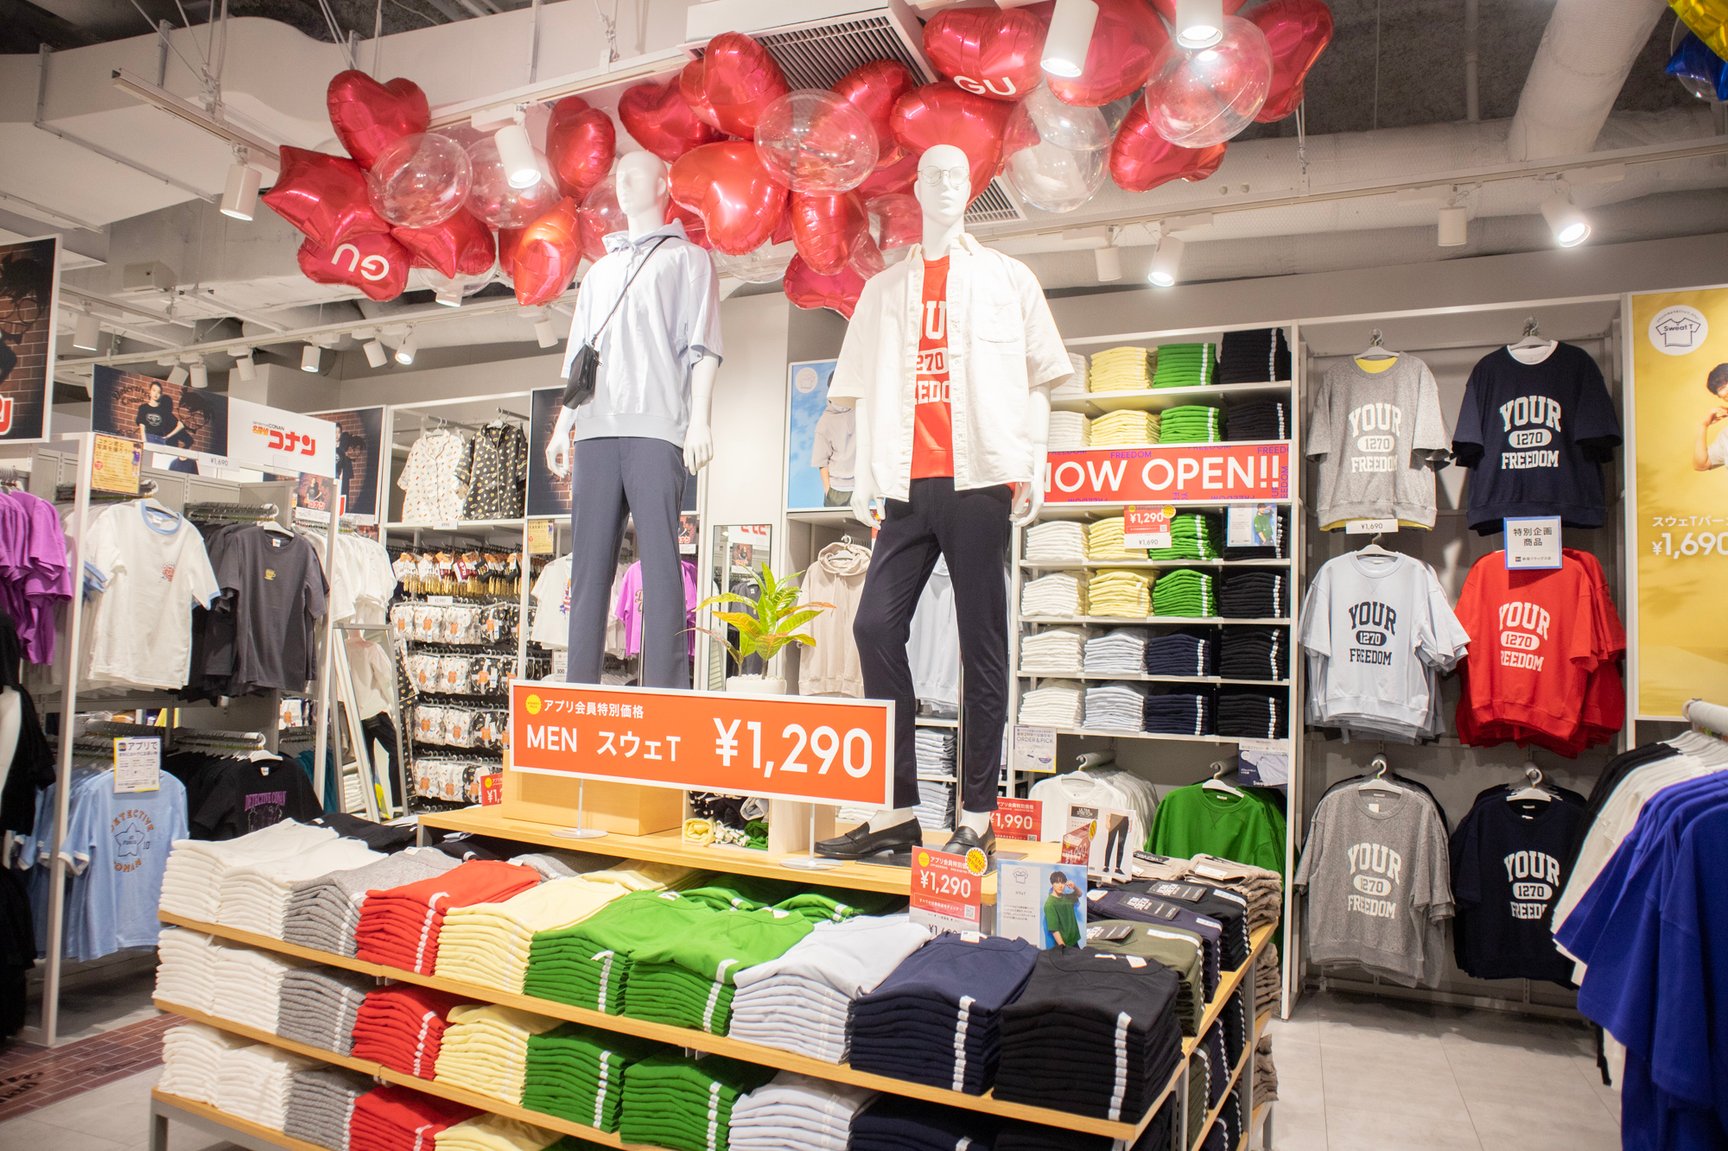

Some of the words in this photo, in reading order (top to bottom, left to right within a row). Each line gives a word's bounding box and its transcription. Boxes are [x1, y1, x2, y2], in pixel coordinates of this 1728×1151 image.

[953, 75, 1017, 96] GU
[330, 243, 390, 281] GU
[915, 351, 944, 372] 270
[1348, 402, 1402, 438] YOUR
[1499, 395, 1562, 432] YOUR
[268, 430, 316, 456] コナン
[1364, 437, 1390, 450] 1270
[1516, 431, 1543, 446] 1270
[1110, 450, 1152, 459] FREEDOM
[1257, 446, 1288, 455] FREED
[1501, 450, 1560, 469] FREEDOM
[1044, 460, 1128, 493] OW
[1141, 455, 1280, 491] OPEN!!
[1351, 455, 1398, 473] FREEDOM
[1130, 513, 1164, 524] ¥1,290
[1361, 523, 1384, 531] ¥1,690
[1652, 514, 1728, 527] スウェTバー
[1513, 526, 1553, 537] 特別企画
[1523, 537, 1543, 547] 商品
[1651, 531, 1728, 560] ¥1,690
[1348, 601, 1397, 636] YOUR
[1498, 601, 1551, 640] YOUR
[1359, 632, 1381, 645] 1270
[1505, 633, 1533, 648] 1270
[1349, 648, 1393, 665] FREEDOM
[543, 699, 645, 719] アプリ会員特別価格
[526, 724, 578, 753] MEN
[596, 730, 681, 762] スウェT
[712, 717, 873, 778] ¥1,290
[1347, 843, 1402, 886] YOUR
[1503, 850, 1560, 888] YOUR
[919, 869, 971, 899] ¥1,290
[1518, 885, 1544, 897] 1270
[1347, 894, 1396, 919] FREEDOM
